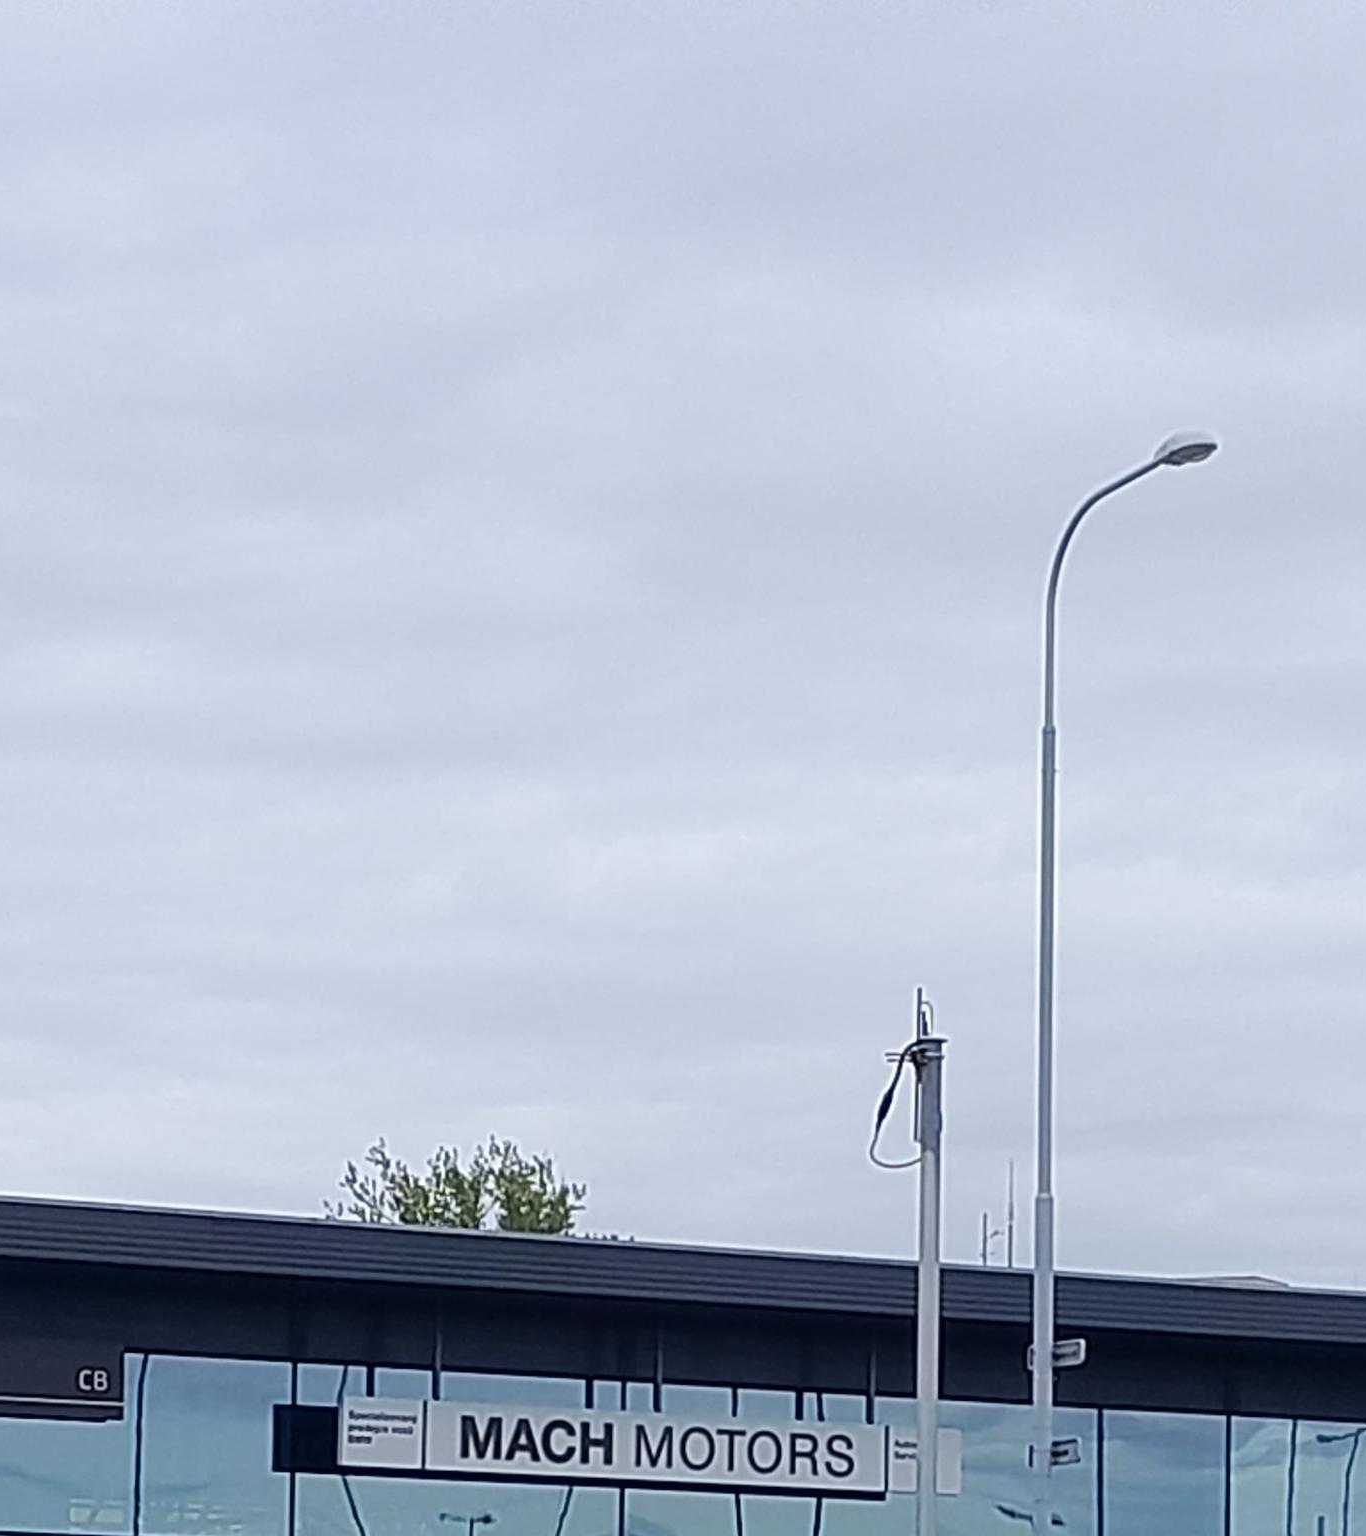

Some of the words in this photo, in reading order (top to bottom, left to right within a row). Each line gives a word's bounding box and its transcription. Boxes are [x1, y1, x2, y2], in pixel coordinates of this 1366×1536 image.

[78, 1369, 109, 1391] CB
[459, 1414, 614, 1466] MACH
[633, 1423, 856, 1478] MOTORS
